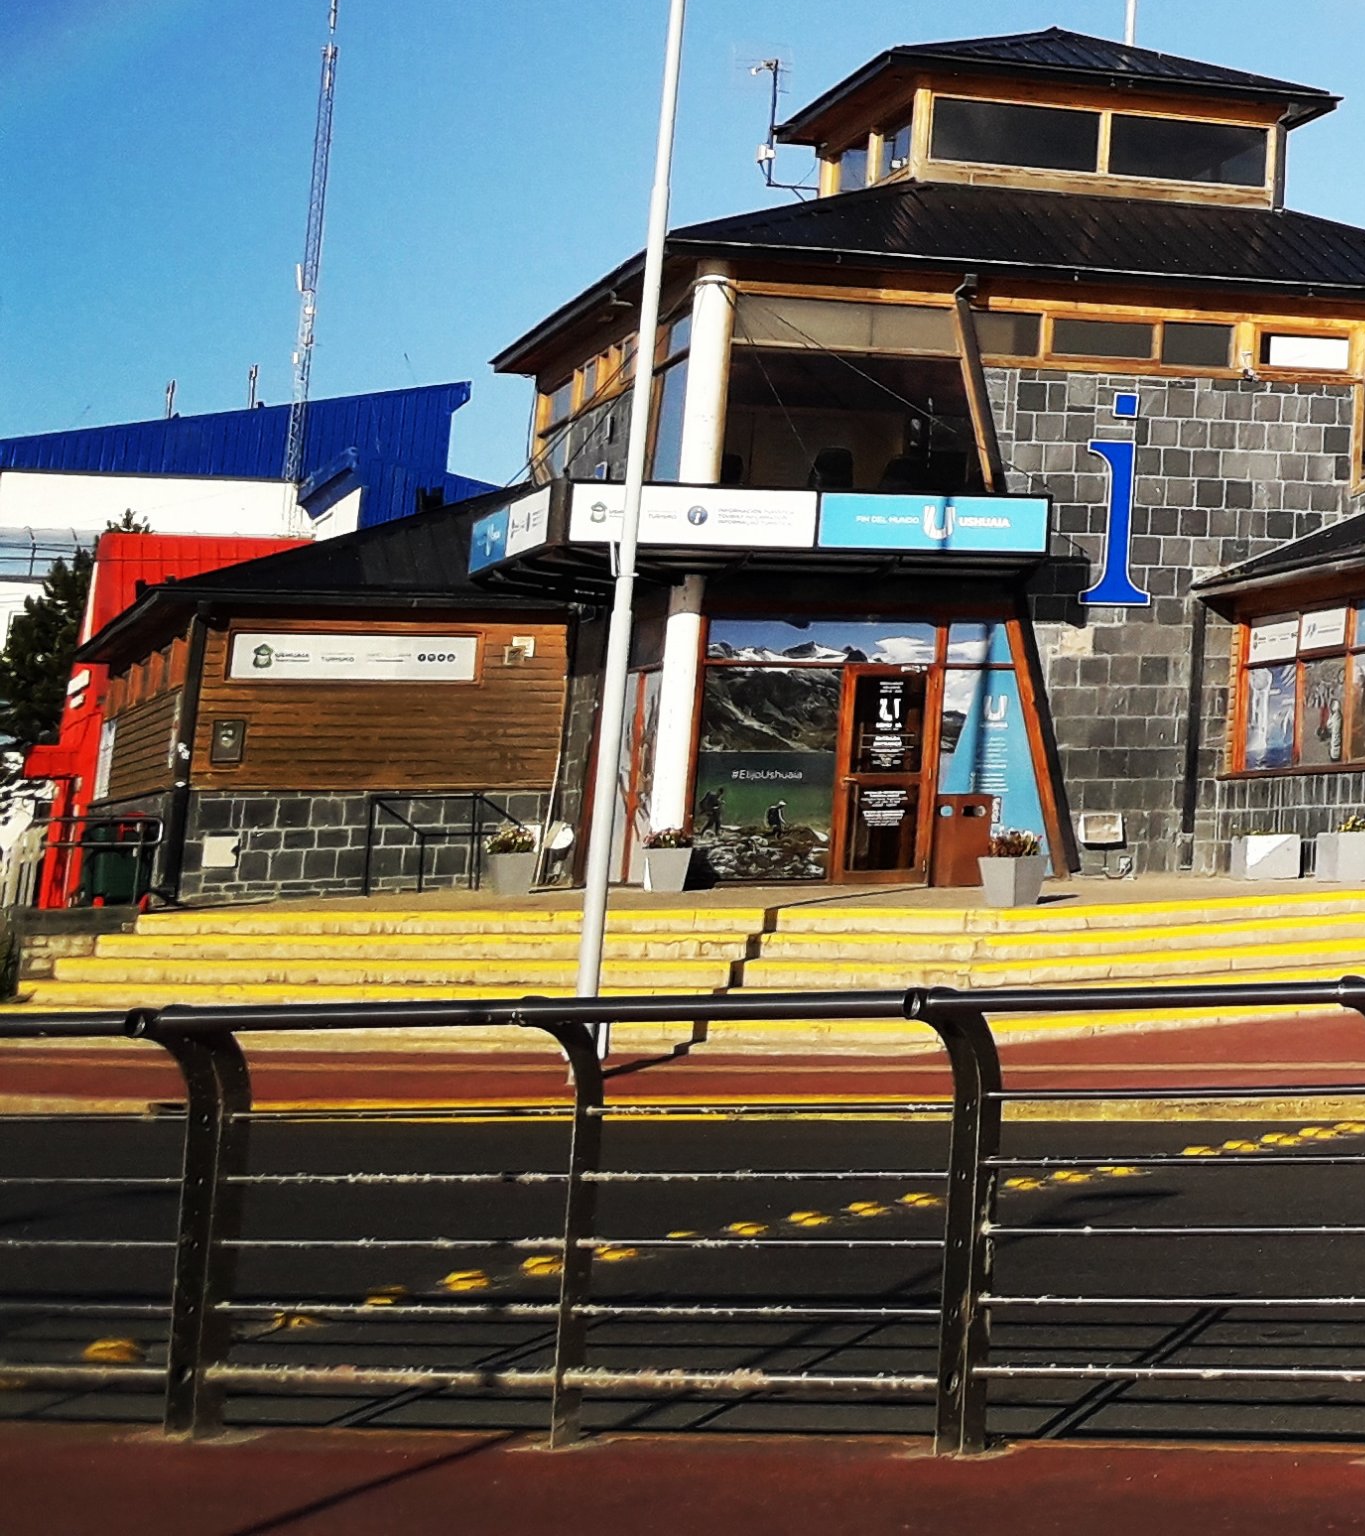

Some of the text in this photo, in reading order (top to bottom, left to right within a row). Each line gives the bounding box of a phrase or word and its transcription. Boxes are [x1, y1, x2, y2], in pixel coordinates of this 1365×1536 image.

[871, 516, 886, 524] DEL
[888, 516, 919, 524] MUNDO
[959, 516, 1010, 528] USHUAIA
